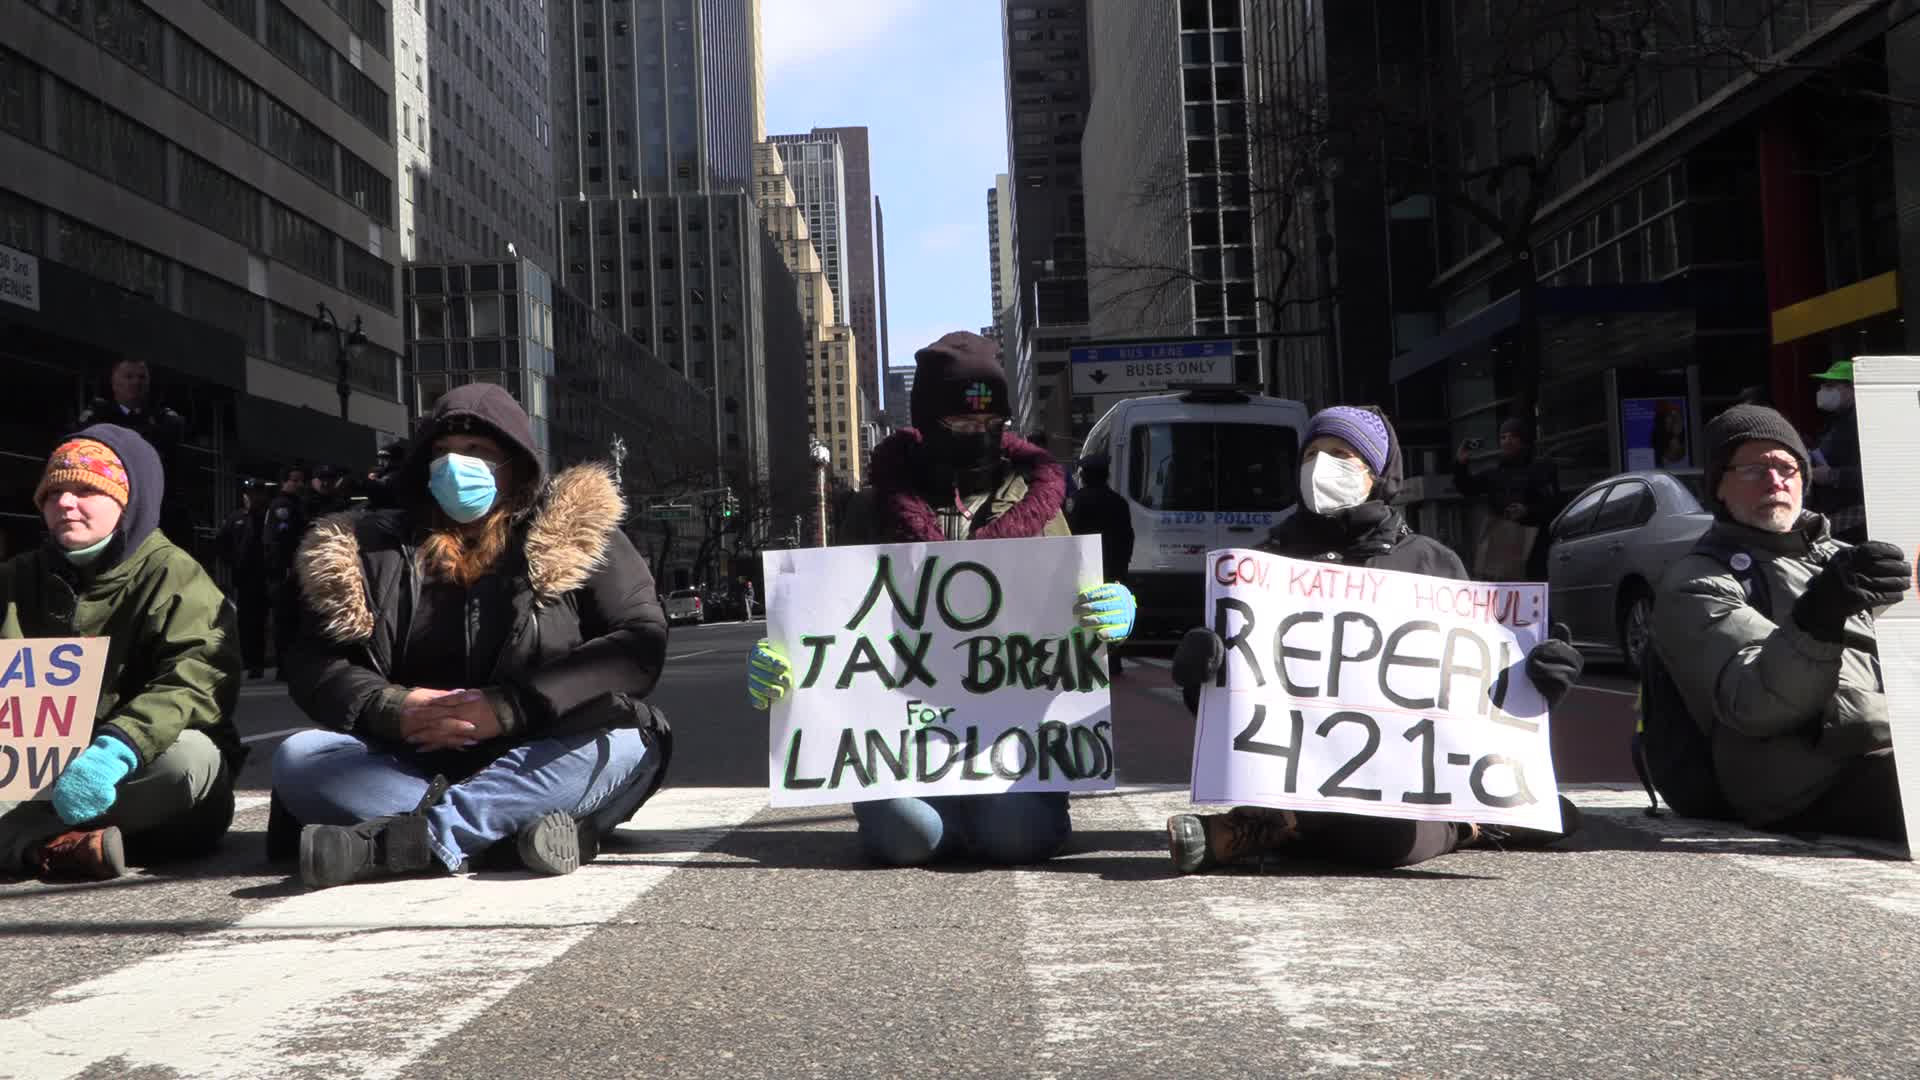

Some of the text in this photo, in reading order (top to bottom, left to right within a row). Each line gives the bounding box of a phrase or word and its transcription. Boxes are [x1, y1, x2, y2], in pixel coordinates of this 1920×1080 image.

[1121, 345, 1145, 359] BUS
[1126, 361, 1216, 377] BUSES ONLY
[1213, 512, 1273, 525] POLICE
[844, 554, 1002, 632] NO
[1215, 554, 1540, 627] GOV. KATHY HOCHUL:
[799, 627, 1110, 694] TAX BREAK
[1215, 597, 1540, 733] REPEAL
[783, 720, 1113, 790] LANDLORDS
[1233, 704, 1538, 808] 421-a
